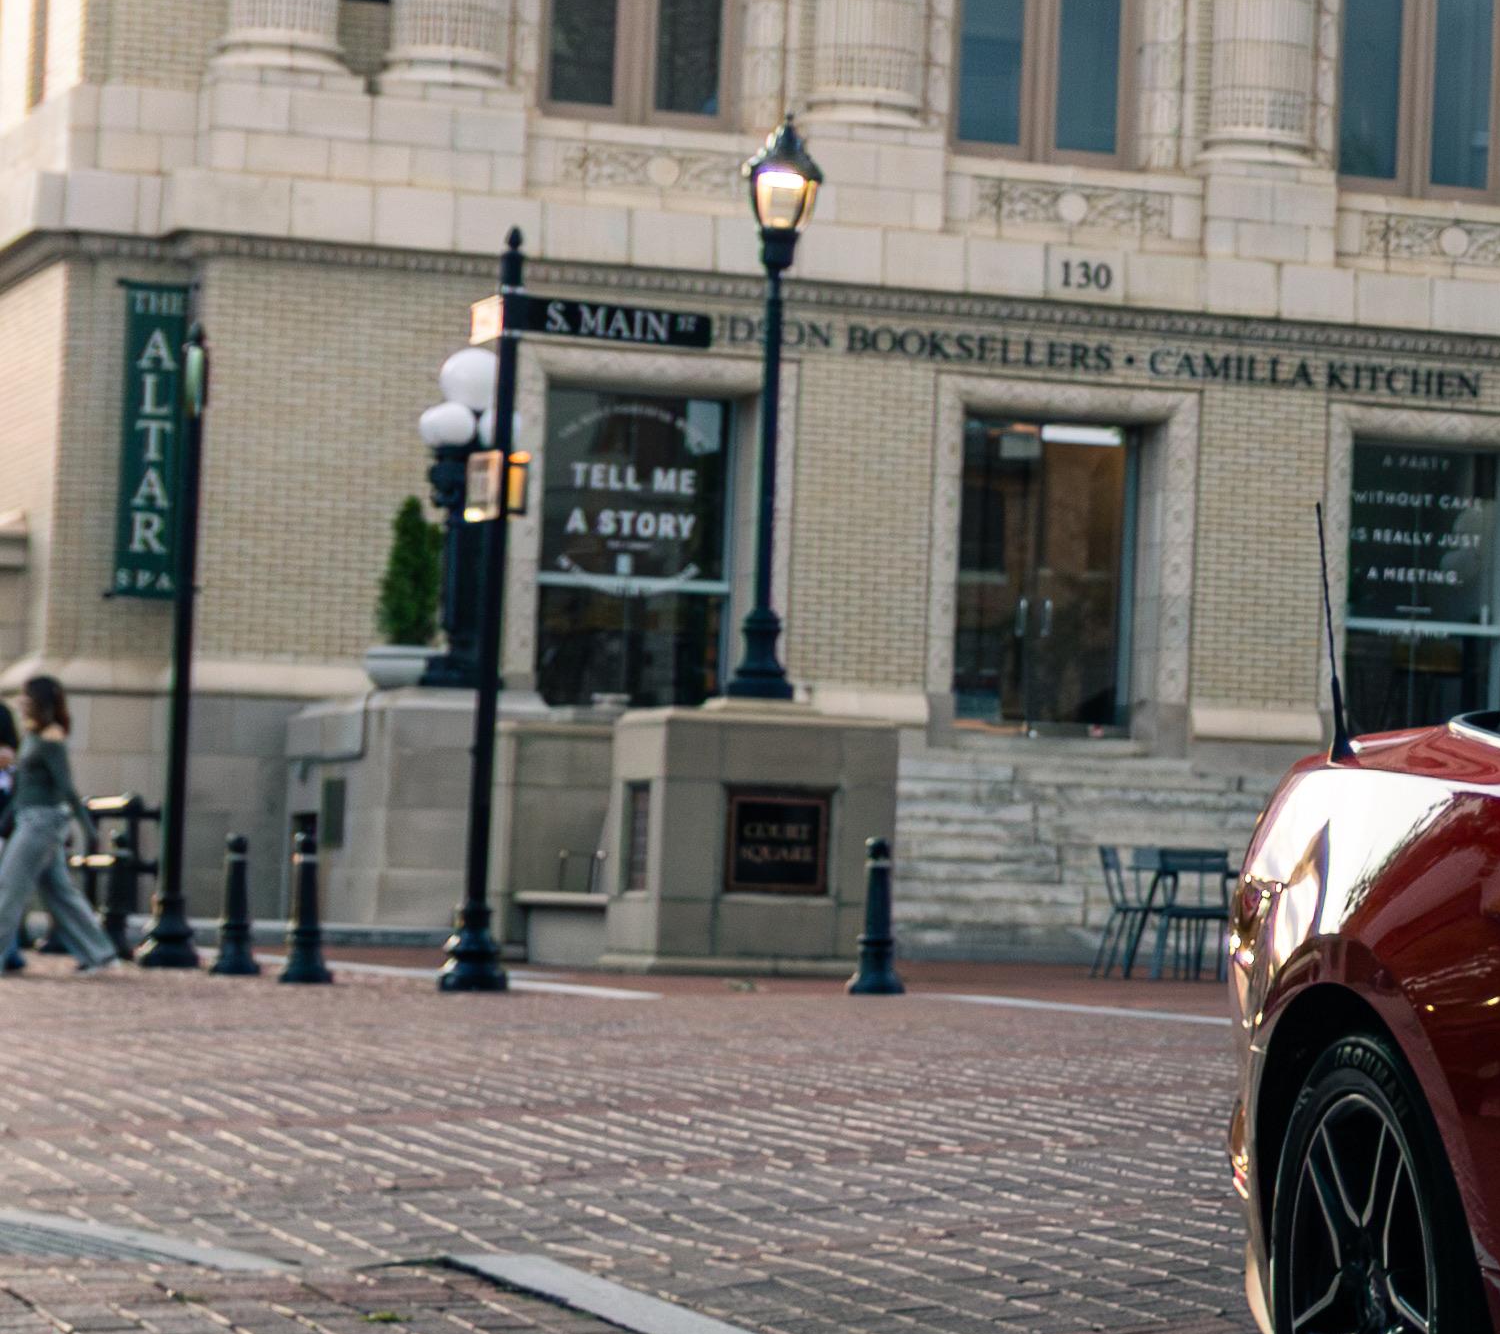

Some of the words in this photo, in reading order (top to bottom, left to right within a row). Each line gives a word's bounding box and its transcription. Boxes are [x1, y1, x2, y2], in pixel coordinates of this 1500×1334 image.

[1062, 259, 1112, 291] 130
[132, 290, 184, 316] THE
[546, 302, 571, 334] S.
[578, 303, 670, 342] MAIN
[846, 323, 1113, 372] BOOKSELLERS
[1149, 348, 1314, 388] CAMILLA
[1326, 360, 1482, 398] KITCHEN
[129, 327, 177, 555] ALTAR
[571, 462, 642, 492] TELL
[653, 467, 698, 495] ME
[1353, 490, 1434, 507] WITHOUT
[564, 507, 589, 534] A
[596, 509, 697, 540] STORY
[1373, 529, 1433, 546] REALLY
[1438, 533, 1481, 548] JUST
[1367, 567, 1378, 580] A
